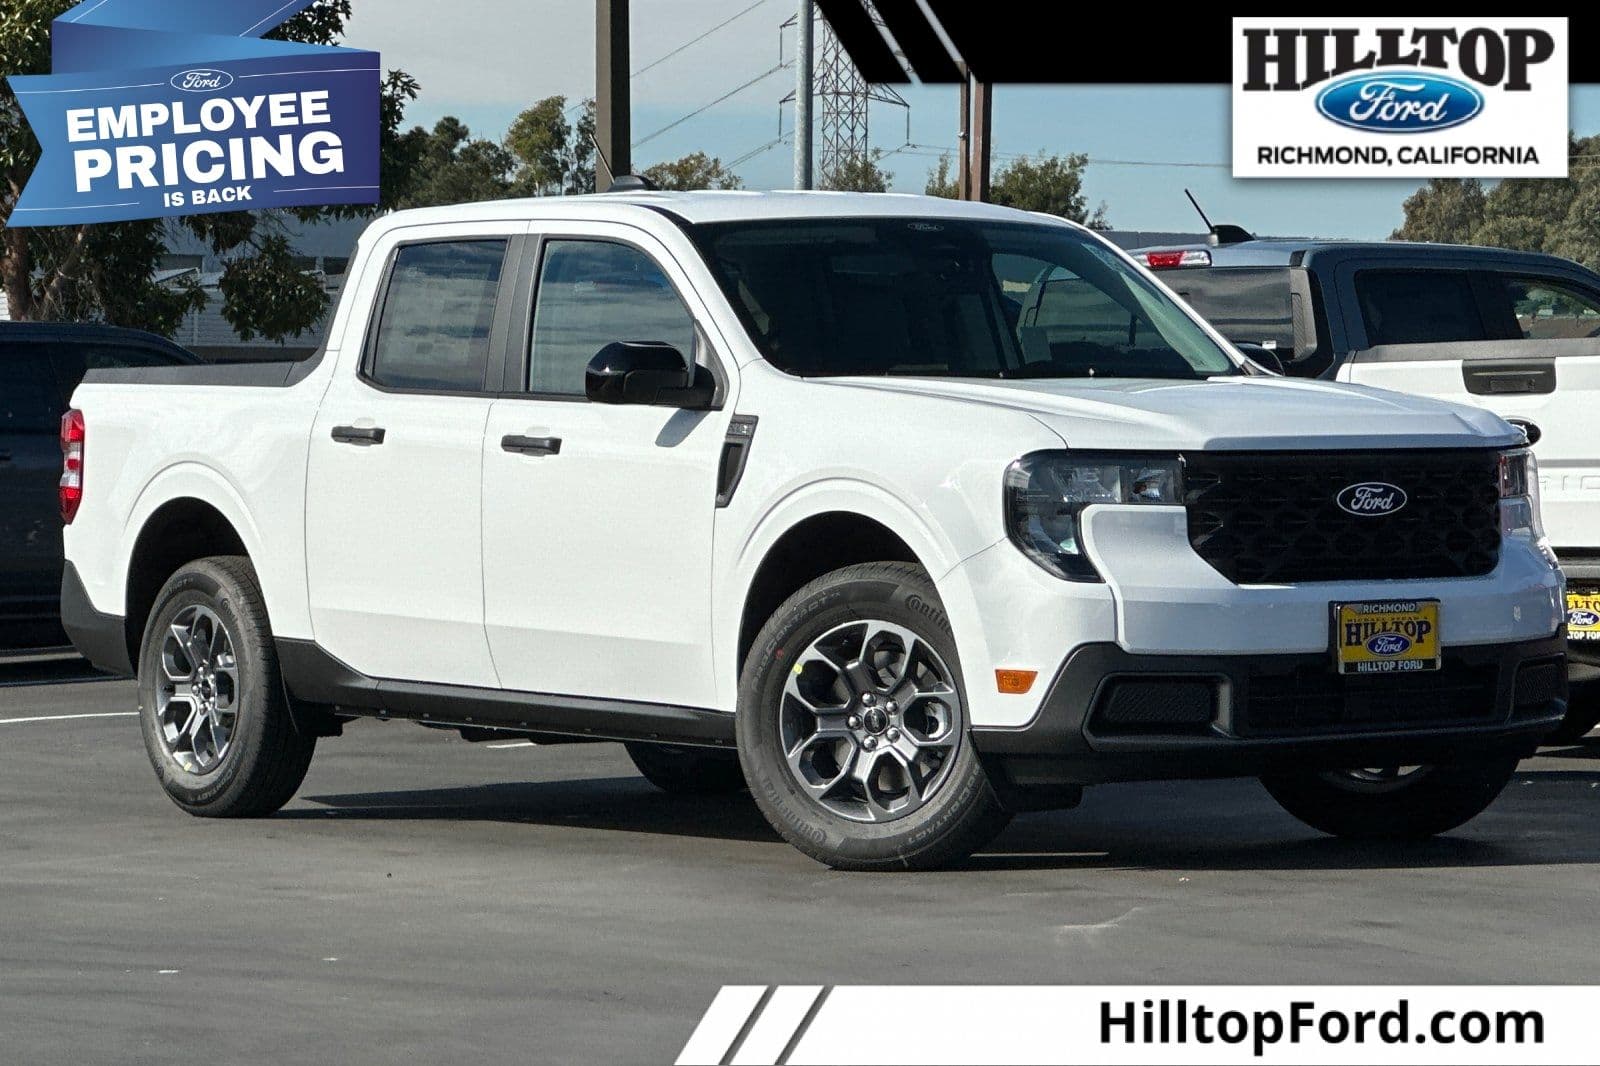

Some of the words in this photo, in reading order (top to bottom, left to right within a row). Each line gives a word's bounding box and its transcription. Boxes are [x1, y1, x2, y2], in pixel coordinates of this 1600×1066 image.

[1350, 486, 1394, 510] Ford
[1363, 603, 1416, 613] RICHMOND
[1570, 611, 1594, 625] Ford
[1345, 620, 1431, 646] HILLTOP
[1374, 636, 1403, 653] Ford
[1358, 661, 1395, 672] HILLTOP
[1398, 660, 1423, 671] FORD
